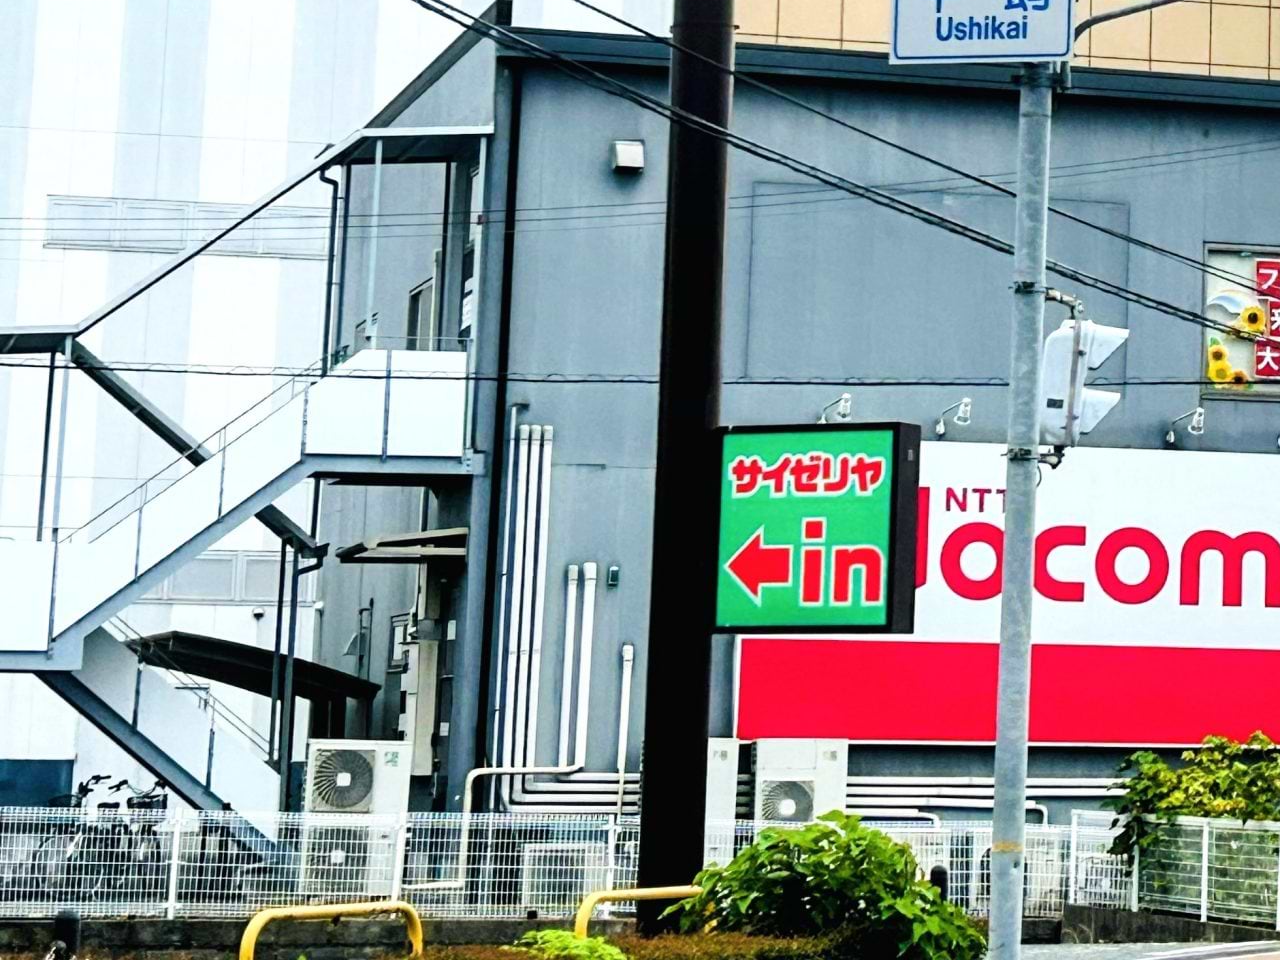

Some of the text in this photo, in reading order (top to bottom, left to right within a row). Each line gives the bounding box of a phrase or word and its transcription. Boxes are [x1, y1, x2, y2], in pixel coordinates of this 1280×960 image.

[936, 15, 1028, 41] Ushikai
[730, 453, 884, 496] サイゼリヤ
[801, 519, 883, 604] in
